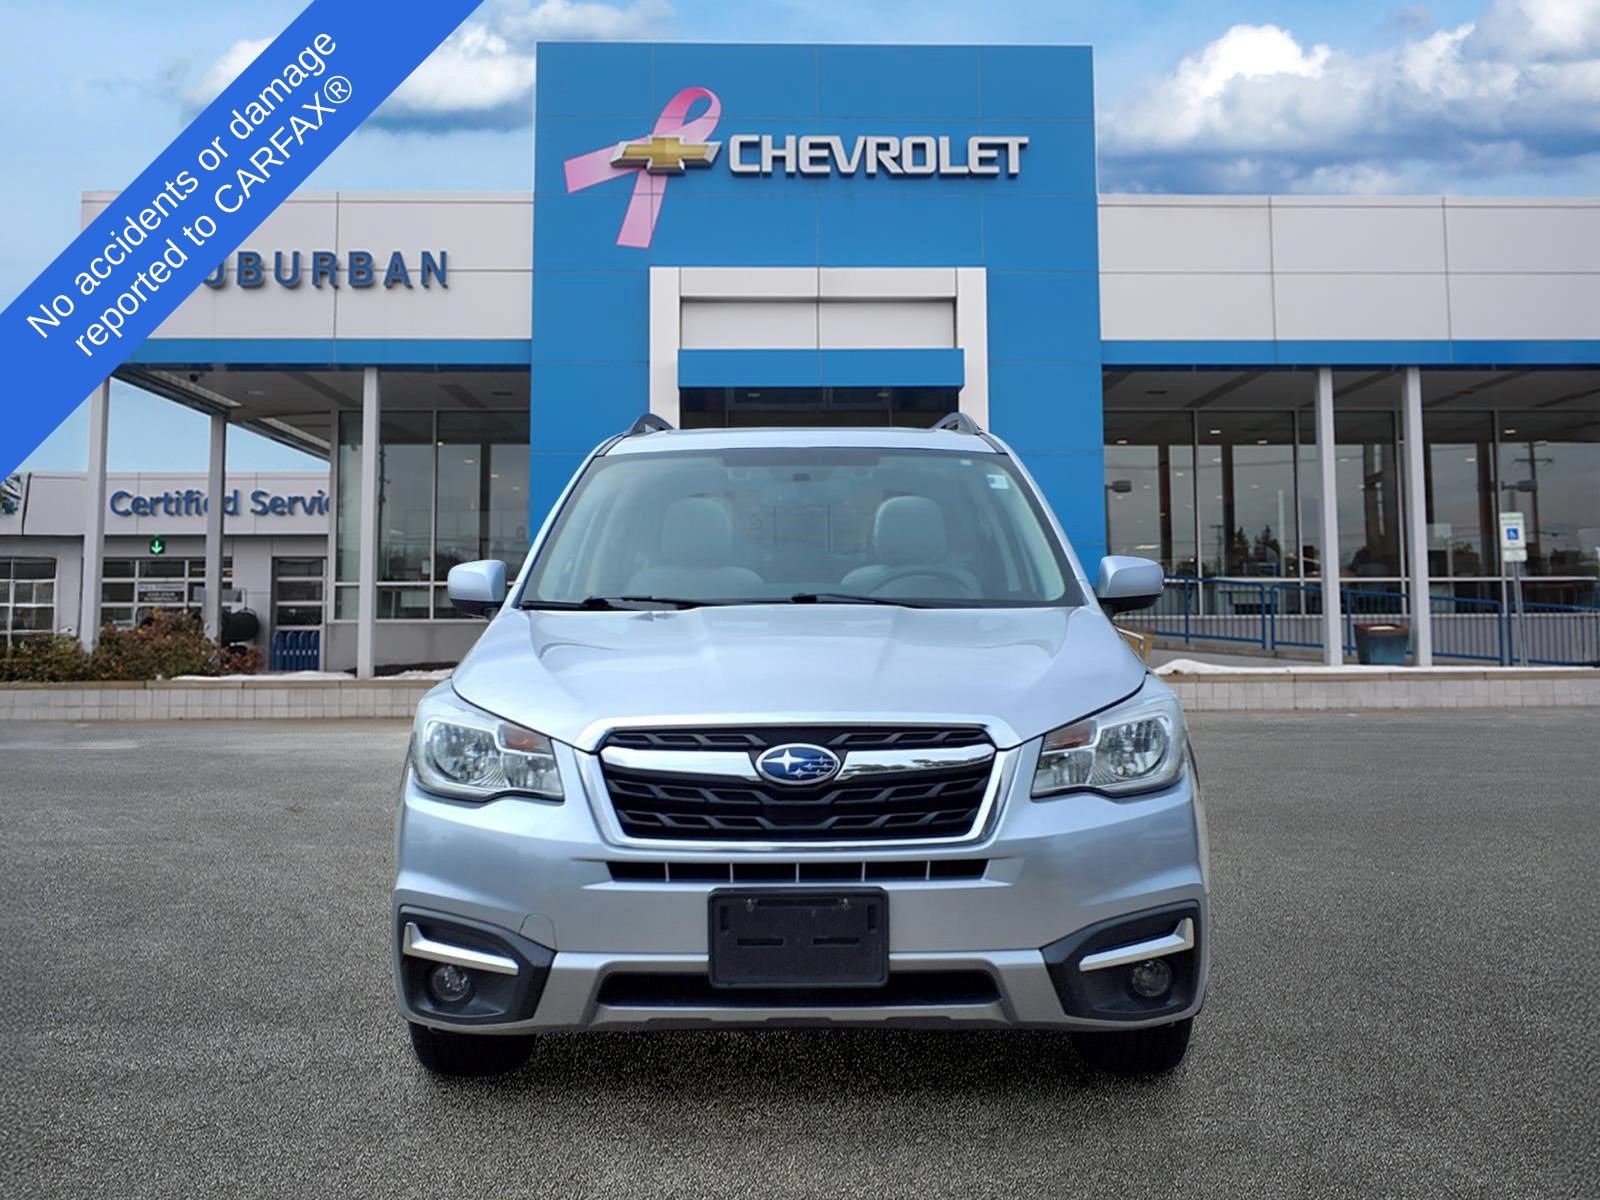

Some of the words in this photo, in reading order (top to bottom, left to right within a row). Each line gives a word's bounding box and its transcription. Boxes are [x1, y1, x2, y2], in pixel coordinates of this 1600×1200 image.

[729, 134, 1029, 177] CHEVROLET
[110, 489, 240, 517] Certifid
[250, 489, 330, 517] Servi
